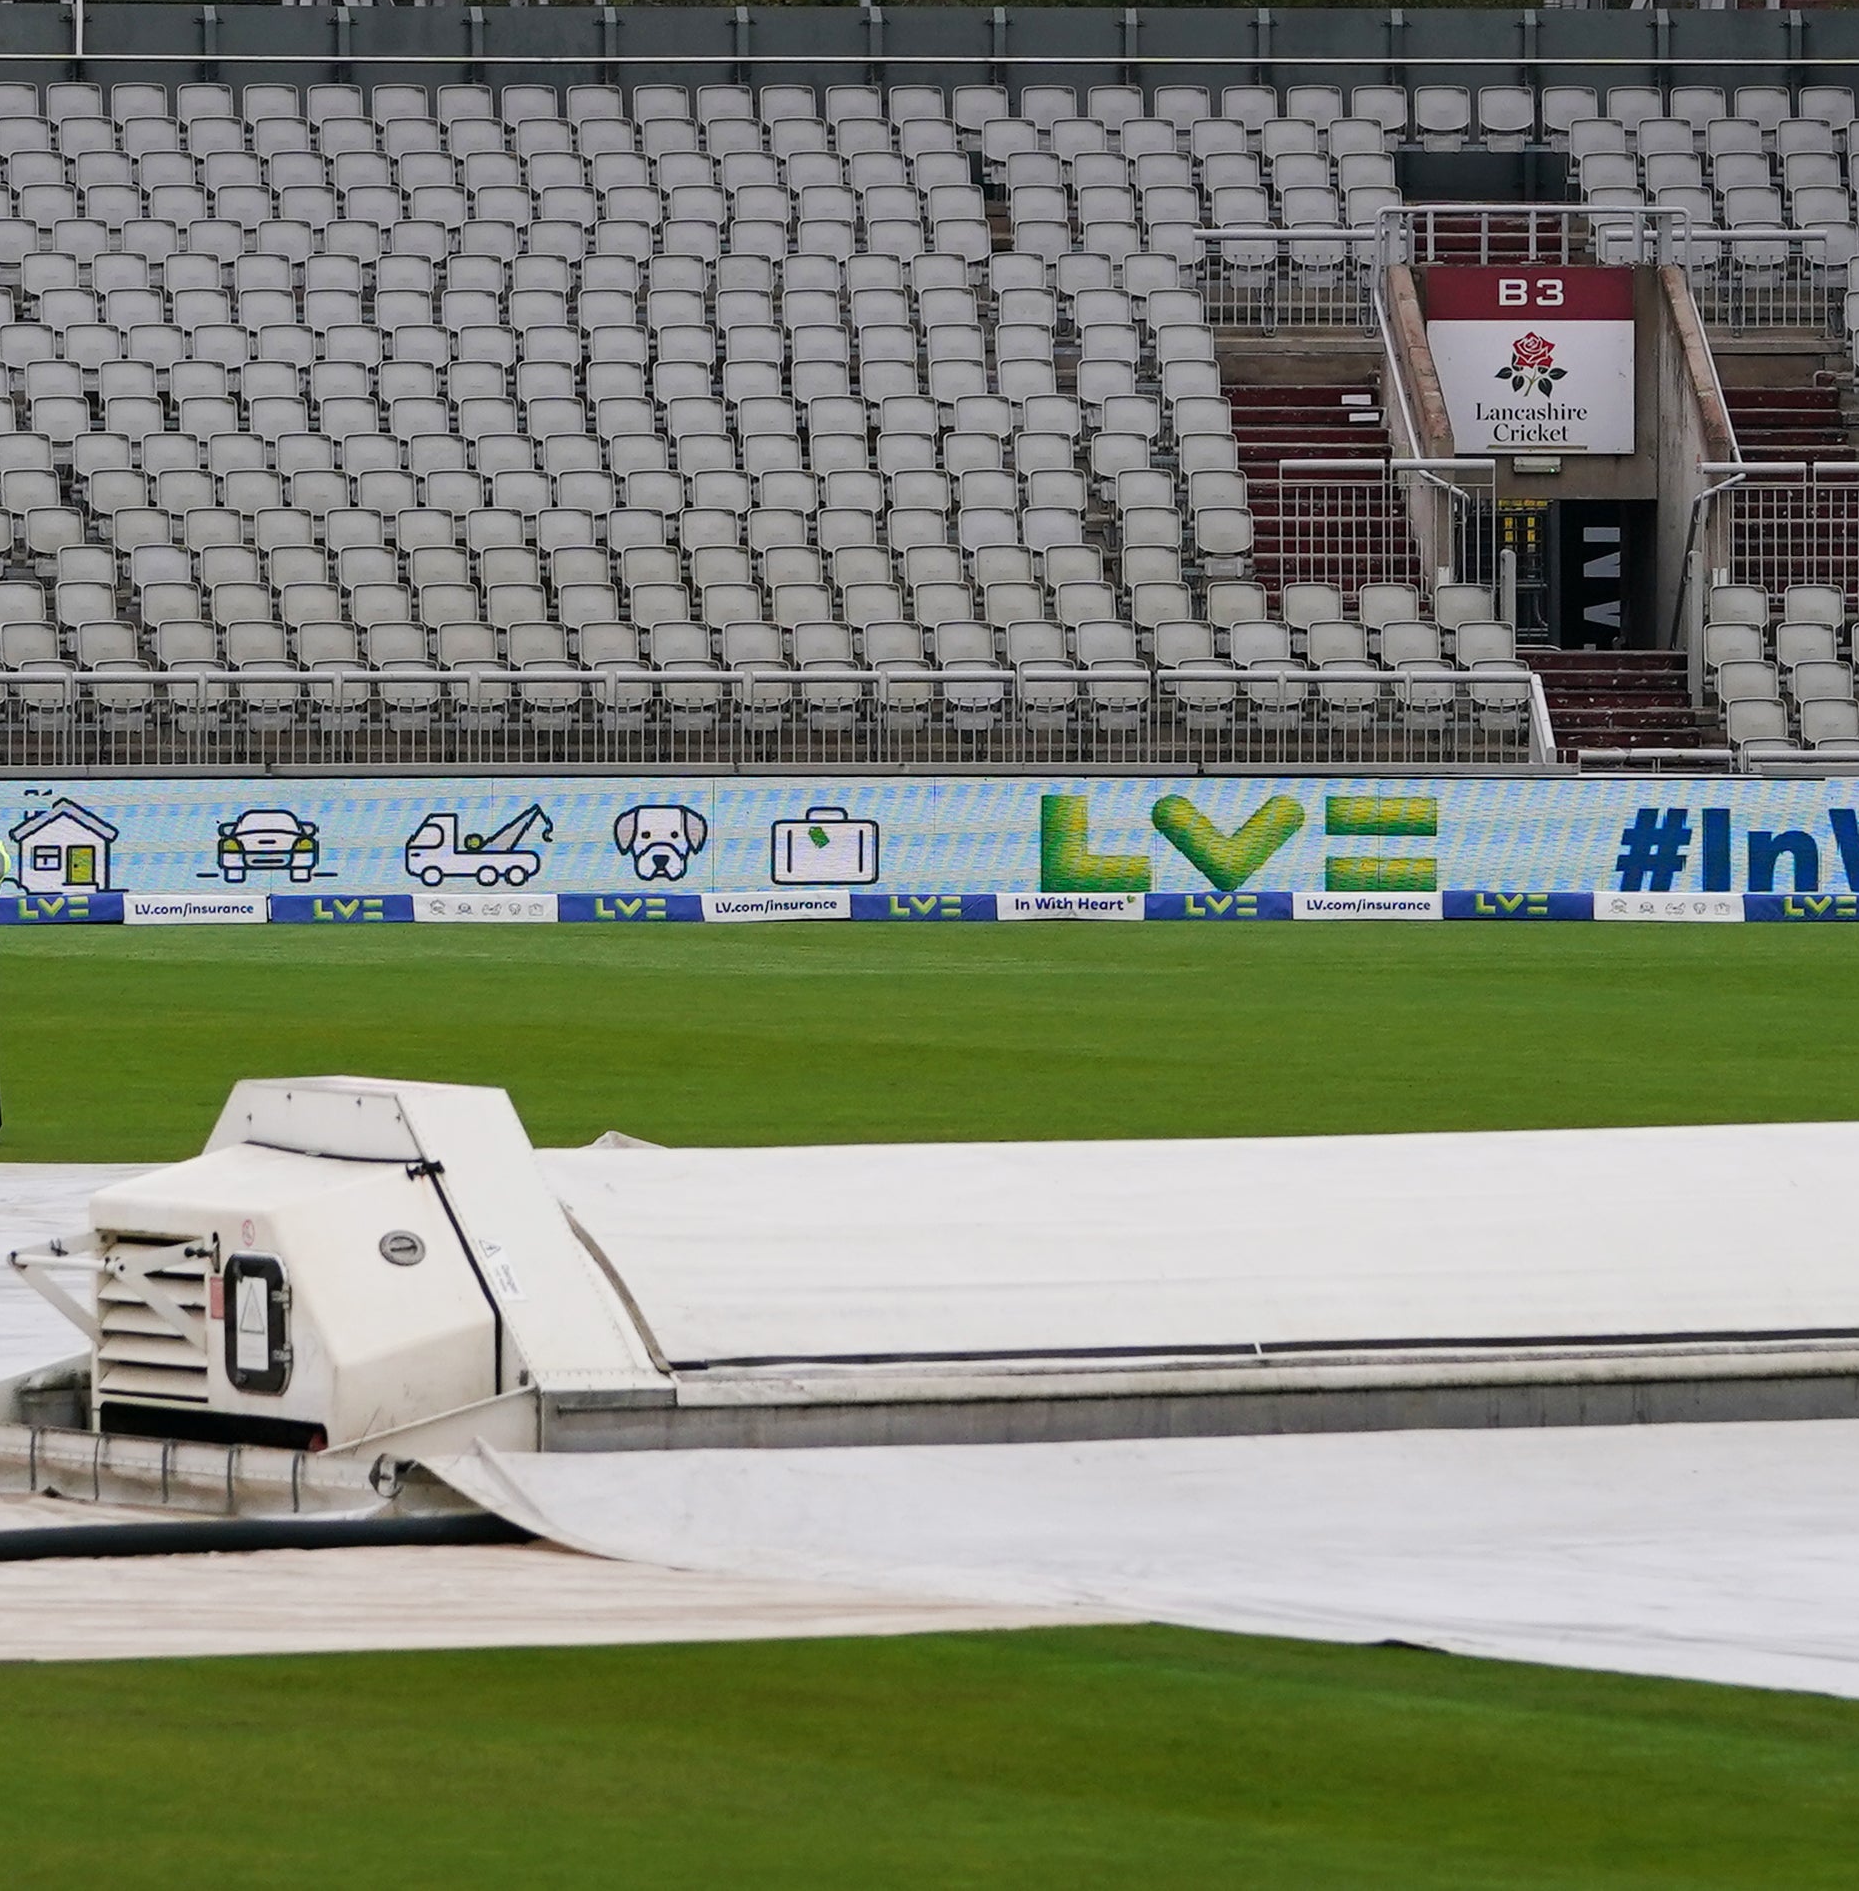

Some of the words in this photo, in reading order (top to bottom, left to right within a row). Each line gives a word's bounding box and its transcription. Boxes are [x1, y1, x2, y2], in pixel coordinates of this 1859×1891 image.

[1498, 278, 1565, 307] B3
[1474, 402, 1588, 422] Lancashire
[1492, 423, 1569, 443] Cricket
[134, 902, 254, 918] LV.com/insurance
[714, 899, 838, 916] LV.com/insurance
[1015, 897, 1029, 911] In
[1035, 896, 1072, 911] With
[1078, 897, 1124, 912] Heart
[1305, 898, 1432, 913] LV.com/insurance
